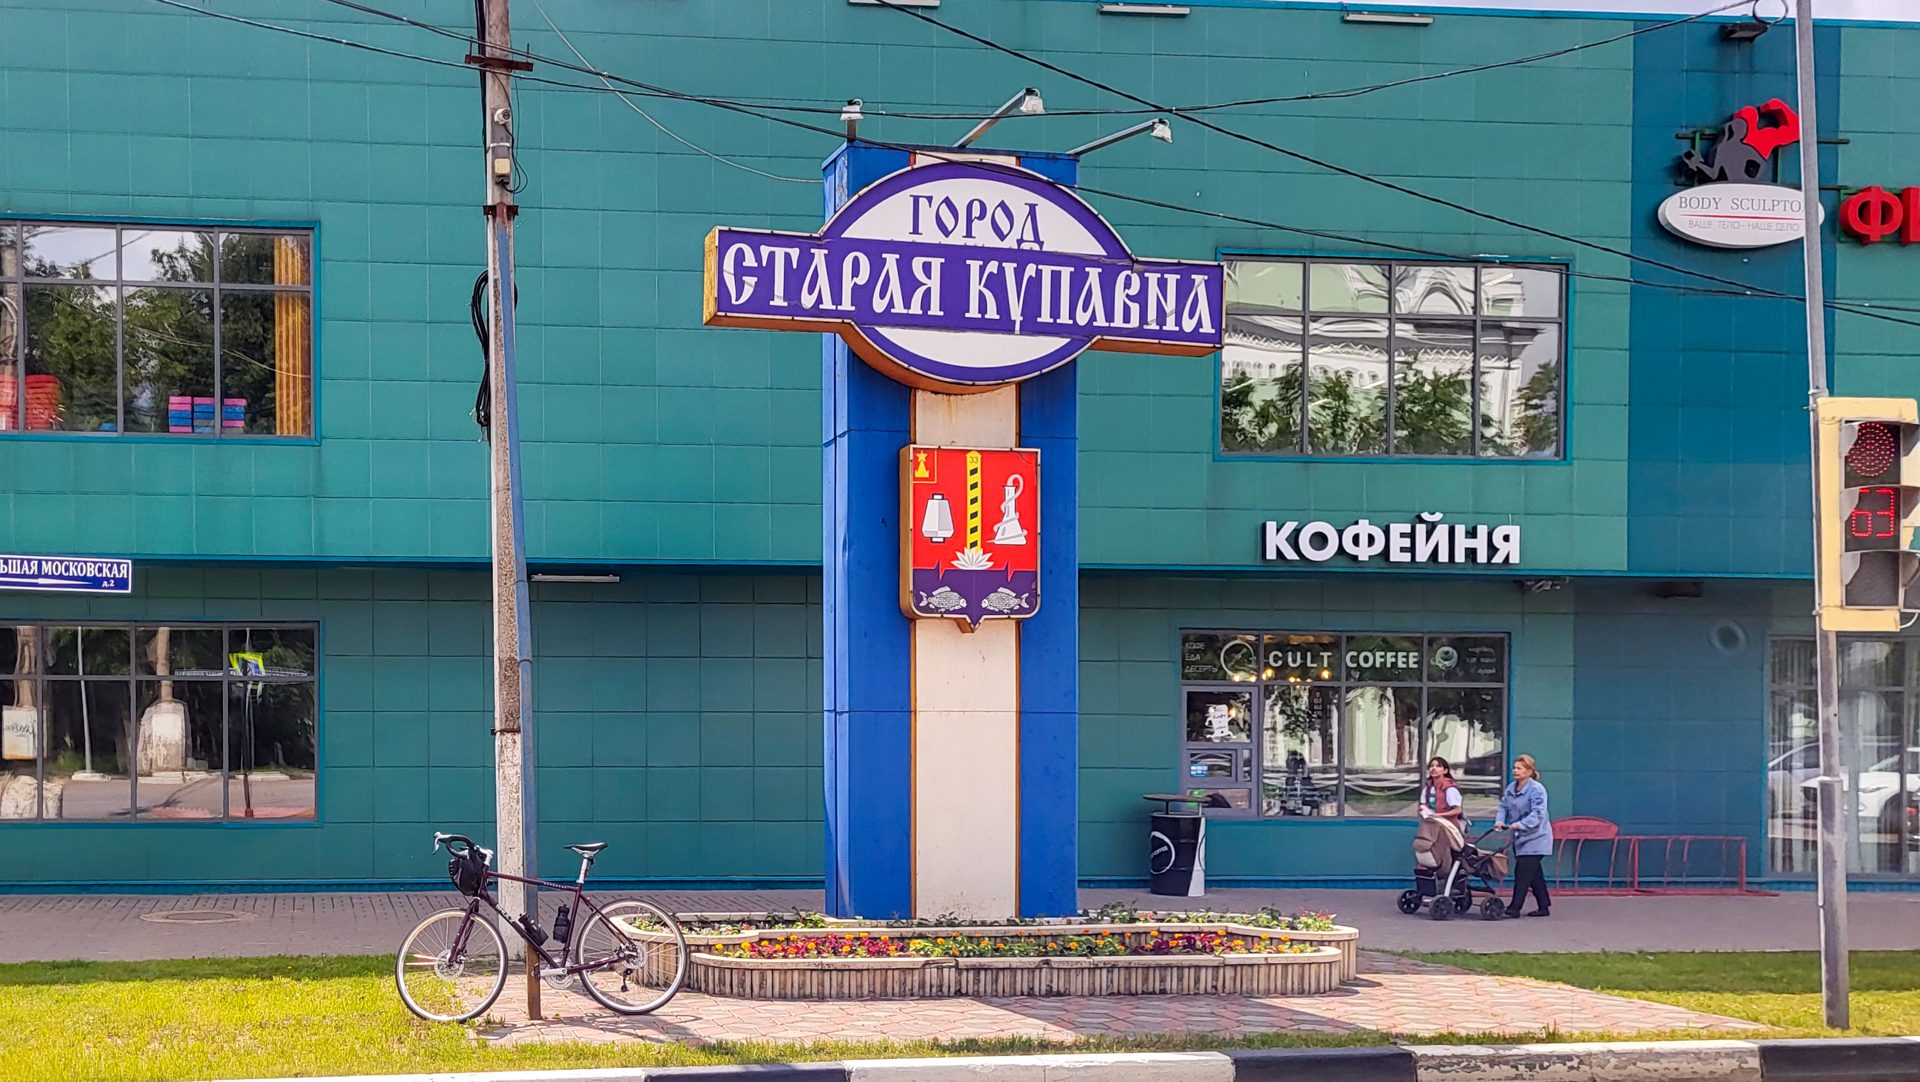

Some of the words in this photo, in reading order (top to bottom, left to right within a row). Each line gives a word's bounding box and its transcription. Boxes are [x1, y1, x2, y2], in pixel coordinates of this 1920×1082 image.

[1679, 196, 1721, 210] BODY
[1731, 198, 1803, 213] SCULPTO
[909, 194, 1045, 250] ГОРОД
[1688, 220, 1713, 230] ВАШЕ
[1747, 221, 1774, 232] НАШЕ
[1775, 223, 1800, 232] ДЕЛО
[723, 243, 945, 316] СТАРАЯ
[965, 259, 1216, 334] КУПАВНА
[969, 456, 979, 464] 33
[1264, 511, 1521, 564] КОФЕЙНЯ
[41, 560, 128, 578] МОСКОВСКАЯ
[1184, 653, 1201, 661] ЕДА
[1268, 650, 1333, 668] CULT
[1345, 651, 1419, 669] COFFEE
